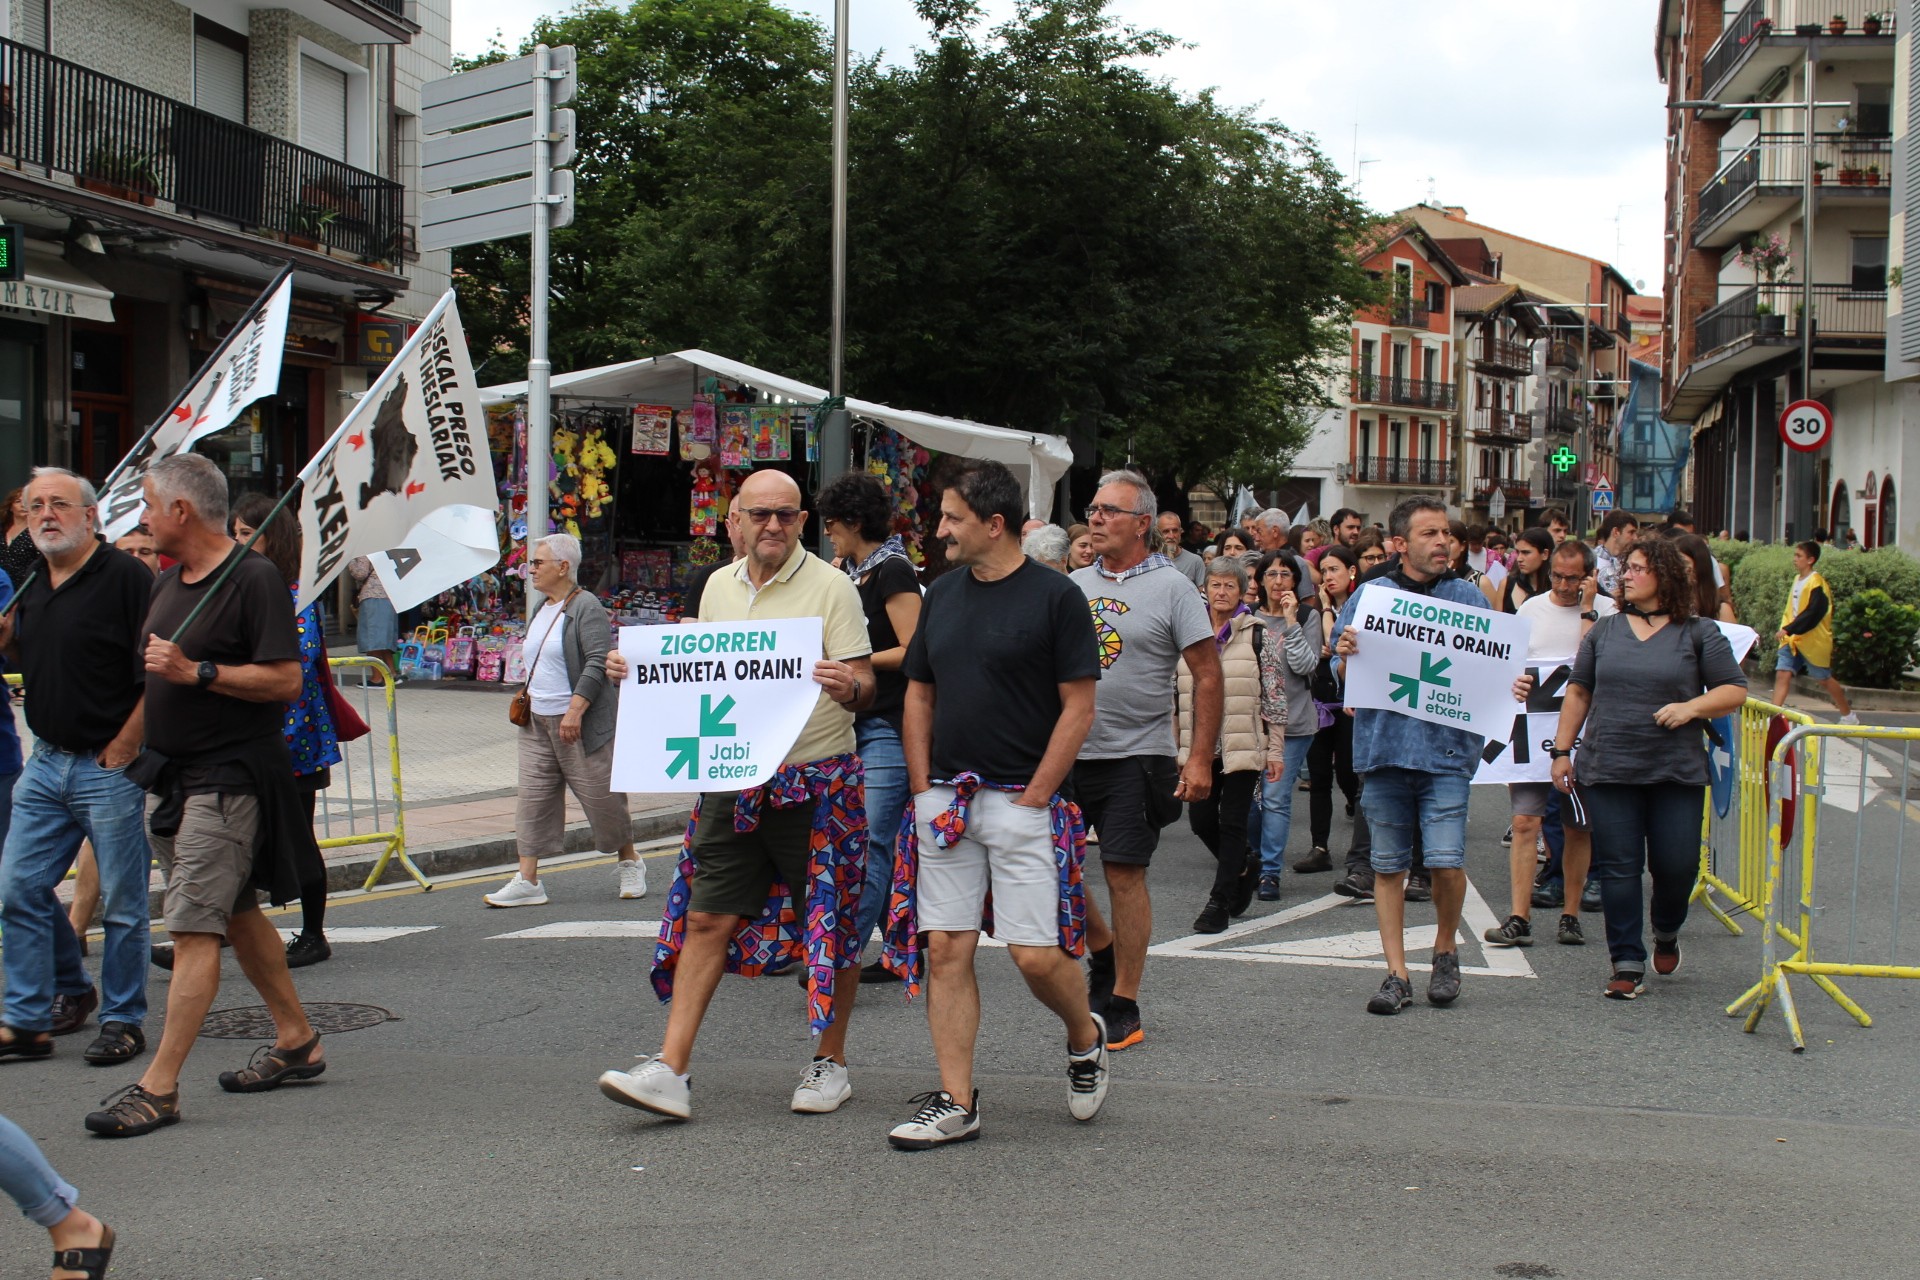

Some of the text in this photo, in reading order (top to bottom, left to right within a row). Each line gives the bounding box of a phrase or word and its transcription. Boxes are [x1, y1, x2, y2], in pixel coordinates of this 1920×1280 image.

[5, 280, 76, 315] MAZIA
[432, 312, 476, 476] EUSKAL PRESO
[420, 357, 462, 482] IHESLARIAK
[1792, 417, 1821, 435] 30
[1390, 597, 1491, 635] ZIGORREN
[660, 630, 777, 656] ZIGORREN
[1363, 614, 1512, 661] BATUKETA ORAIN!
[637, 657, 802, 685] BATUKETA ORAIN!
[1426, 689, 1462, 707] Jabi
[1425, 703, 1471, 722] etxera
[709, 741, 751, 761] Jabi
[708, 763, 758, 779] etxera
